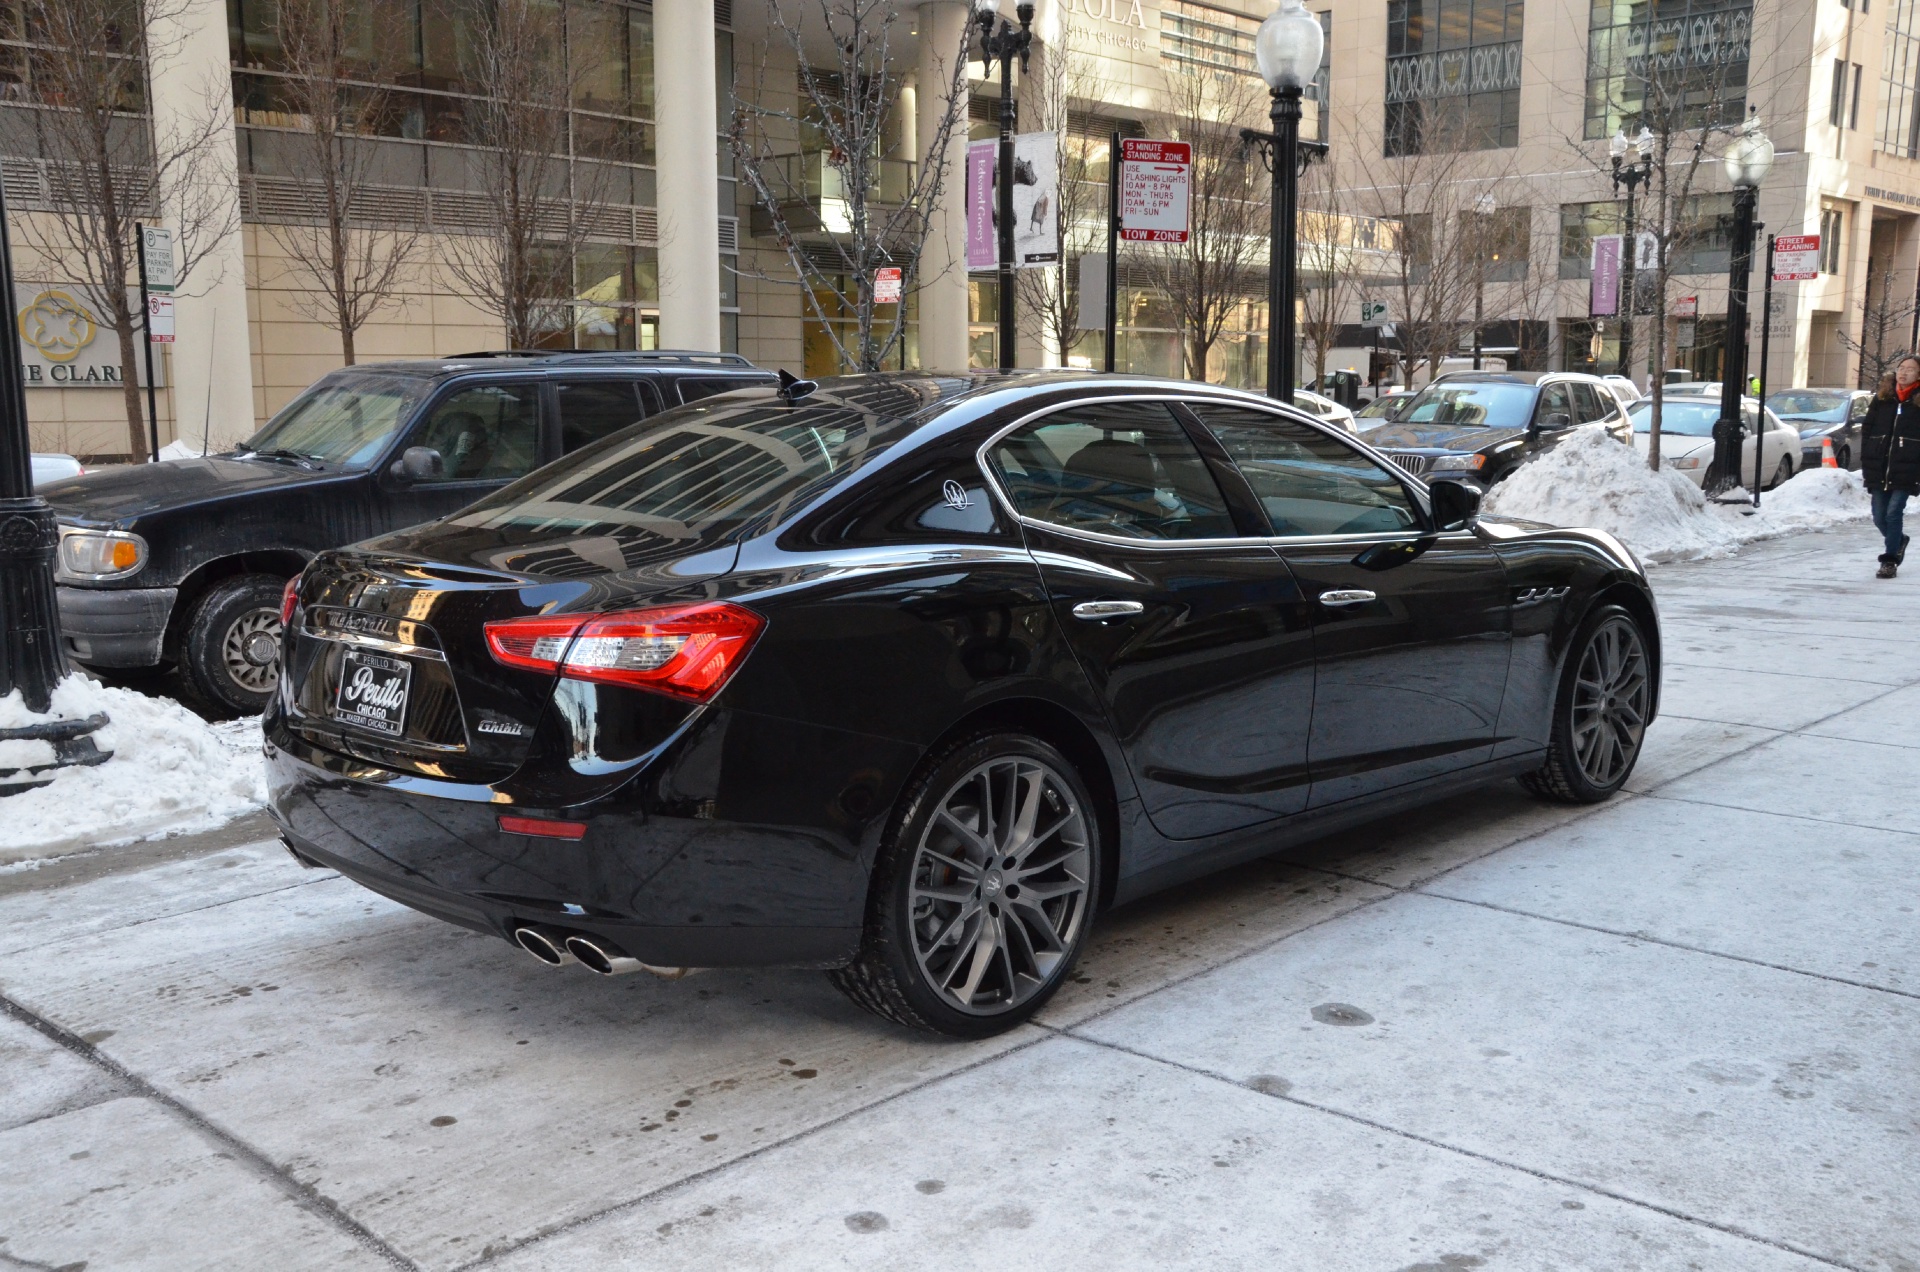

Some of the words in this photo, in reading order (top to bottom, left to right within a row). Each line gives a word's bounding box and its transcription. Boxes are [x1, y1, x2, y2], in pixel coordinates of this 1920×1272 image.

[1097, 31, 1148, 52] CHICAGO
[1126, 142, 1134, 150] 15
[1136, 143, 1162, 152] MINUTE
[1126, 151, 1161, 160] STANDING
[1164, 153, 1183, 162] ZONE
[977, 159, 986, 204] Edward
[1125, 173, 1160, 182] FLASHING
[1162, 175, 1186, 184] LIGHTS
[1160, 183, 1171, 191] PM
[1125, 190, 1141, 198] MON
[1150, 191, 1174, 200] THURS
[1125, 207, 1137, 215] FRI
[1143, 208, 1160, 216] SUN
[975, 206, 986, 243] Gorey
[1125, 229, 1148, 240] TOW
[1153, 231, 1183, 241] ZONE
[1778, 237, 1805, 245] STREET
[1777, 243, 1815, 251] CLEANING
[159, 252, 170, 260] FOR
[146, 259, 172, 268] PARKING
[147, 274, 160, 282] BOX
[327, 611, 394, 636] Maserati
[363, 655, 389, 668] PERILLO
[345, 666, 404, 710] Perillo
[356, 703, 387, 719] CHICAGO
[346, 713, 367, 725] MASERATI
[367, 717, 387, 730] CHICAGO
[477, 719, 523, 736] Ghibli
